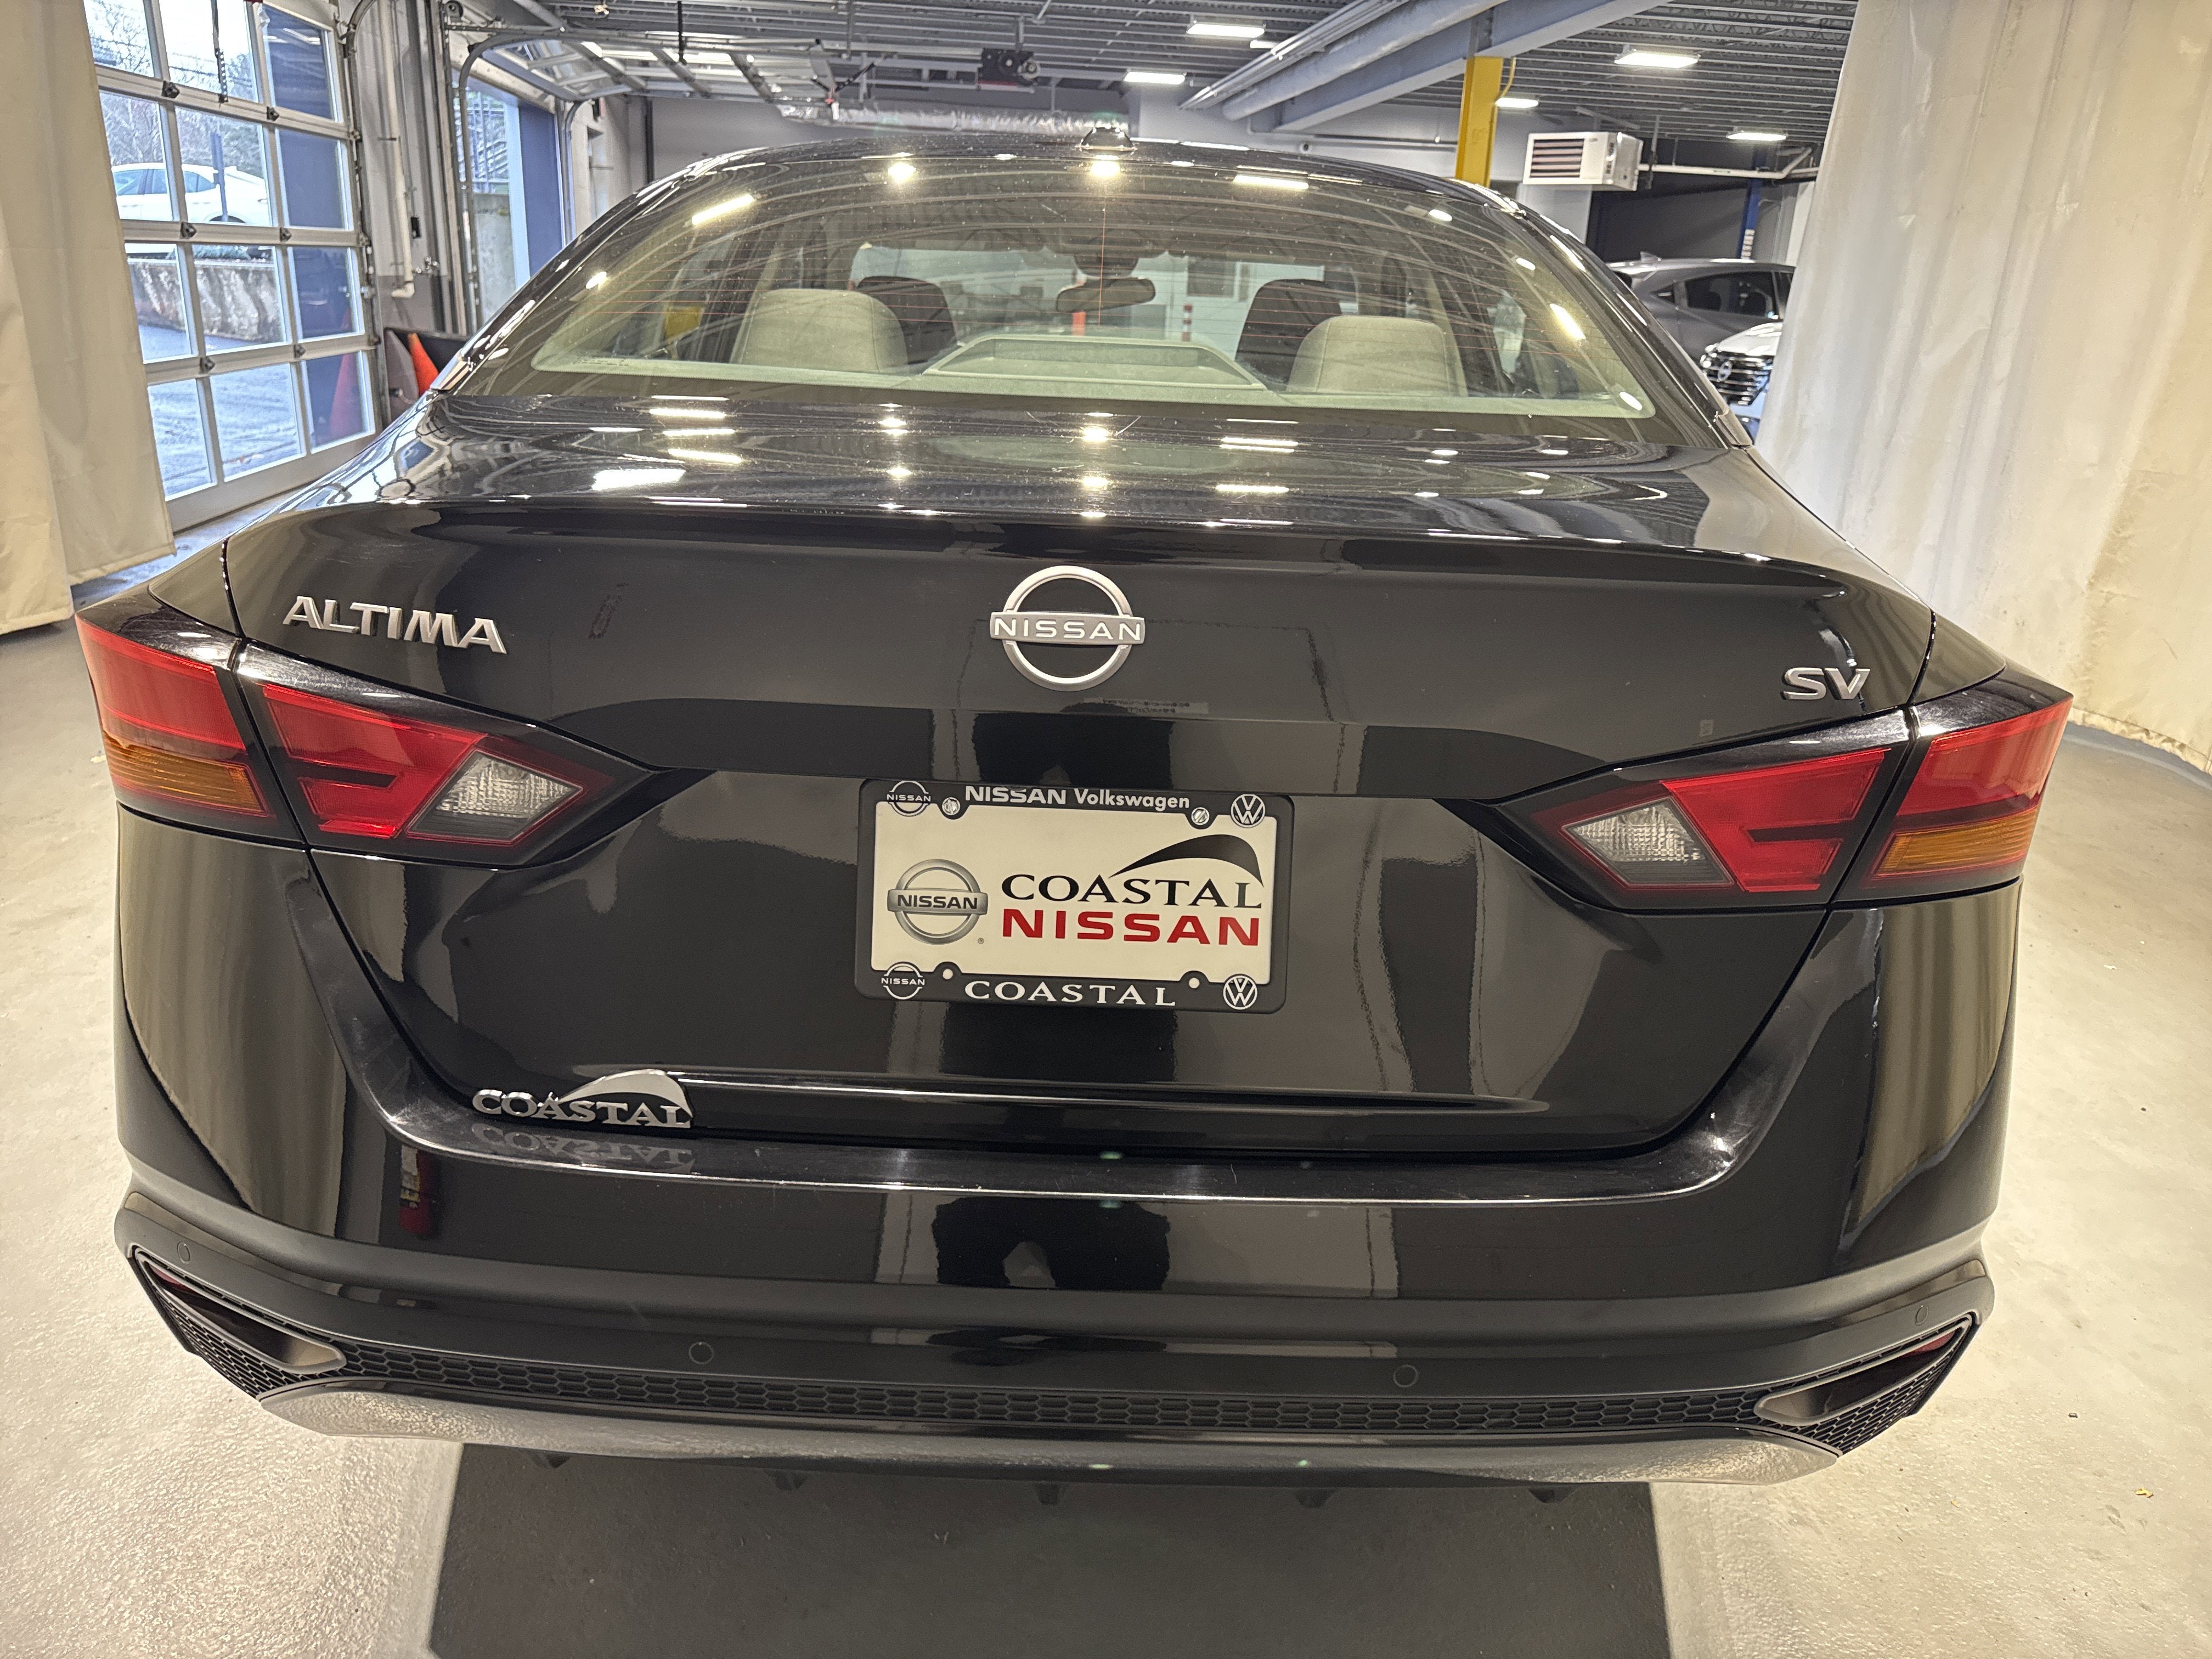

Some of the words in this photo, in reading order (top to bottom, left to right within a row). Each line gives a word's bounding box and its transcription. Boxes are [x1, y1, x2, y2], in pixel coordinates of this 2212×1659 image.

[282, 596, 507, 654] ALTIMA
[994, 617, 1141, 641] NISSAN
[1784, 667, 1871, 700] SV
[887, 794, 931, 802] NISSAN
[965, 786, 1066, 805] NISSAN
[1074, 788, 1190, 812] Volkswagen
[898, 894, 978, 910] NISSAN
[1001, 874, 1262, 909] COASTAL
[1002, 908, 1260, 946] NISSAN
[881, 977, 925, 986] NISSAN
[964, 980, 1176, 1007] COASTAL
[472, 1089, 691, 1128] COASTAL
